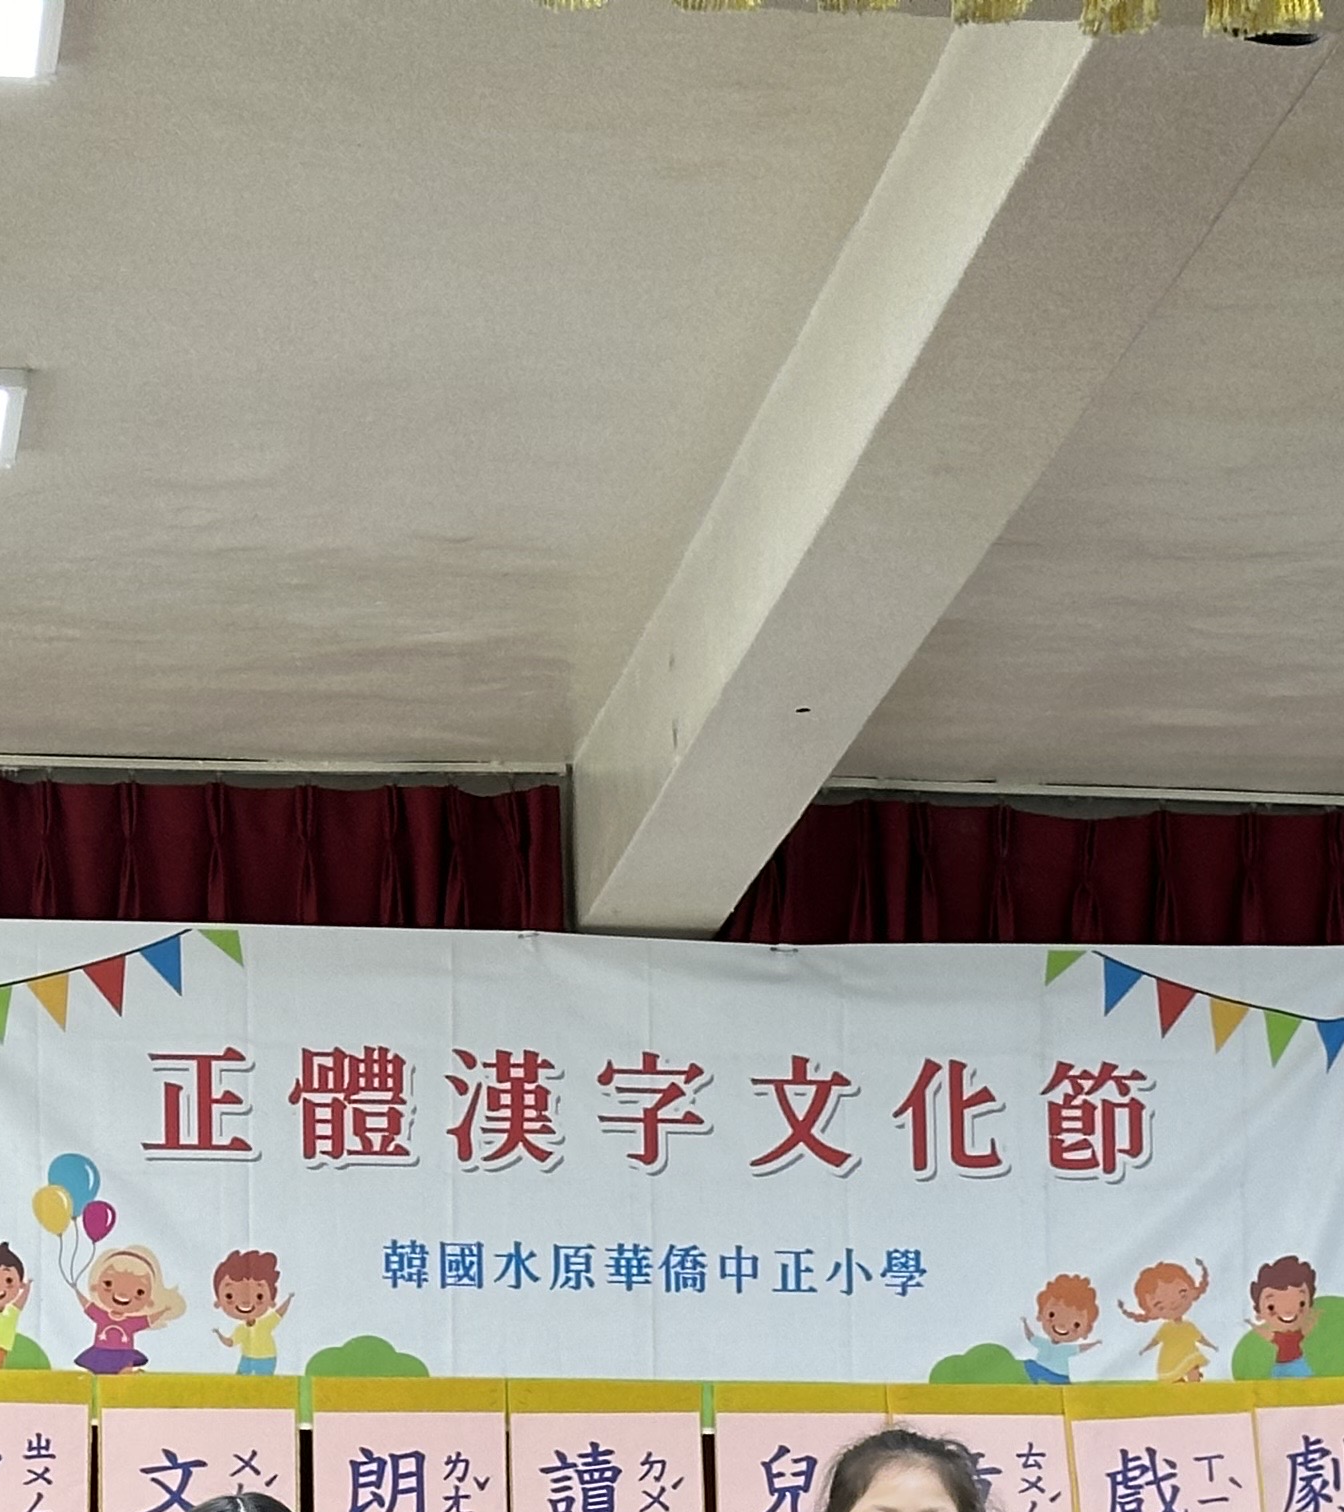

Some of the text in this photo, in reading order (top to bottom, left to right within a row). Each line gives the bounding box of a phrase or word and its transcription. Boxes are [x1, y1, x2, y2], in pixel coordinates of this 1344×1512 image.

[142, 1045, 1147, 1174] 正體漢字文化節
[382, 1240, 928, 1298] 韓國水原華僑中正小學
